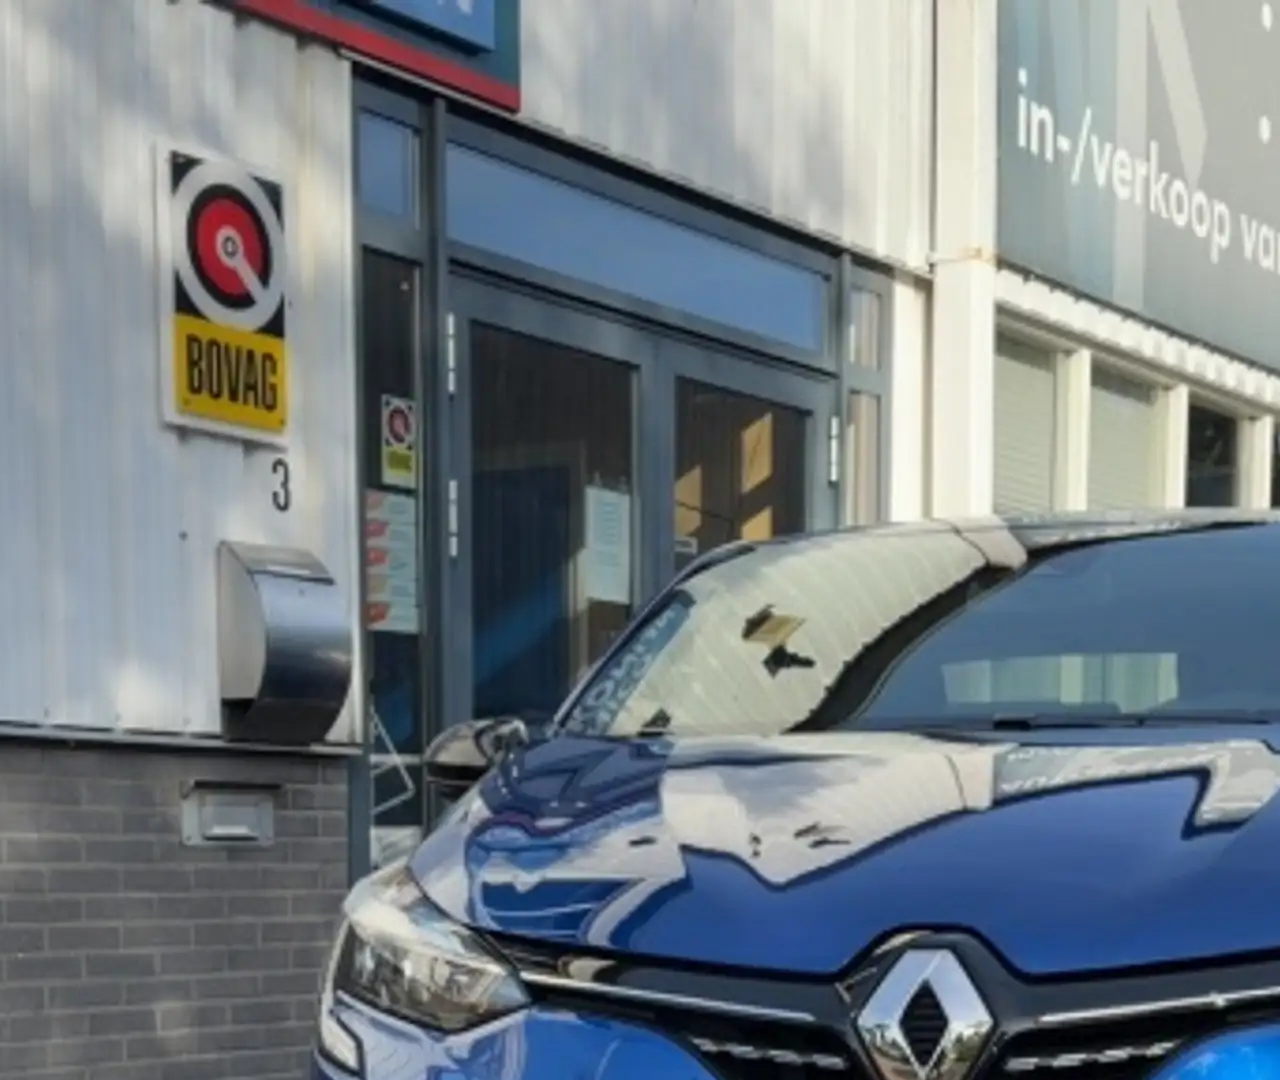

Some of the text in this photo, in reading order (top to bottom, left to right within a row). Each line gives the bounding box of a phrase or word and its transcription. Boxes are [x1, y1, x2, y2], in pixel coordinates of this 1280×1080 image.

[1018, 67, 1231, 264] in-/verkoop
[186, 333, 279, 414] BOVAG
[272, 458, 290, 512] 3
